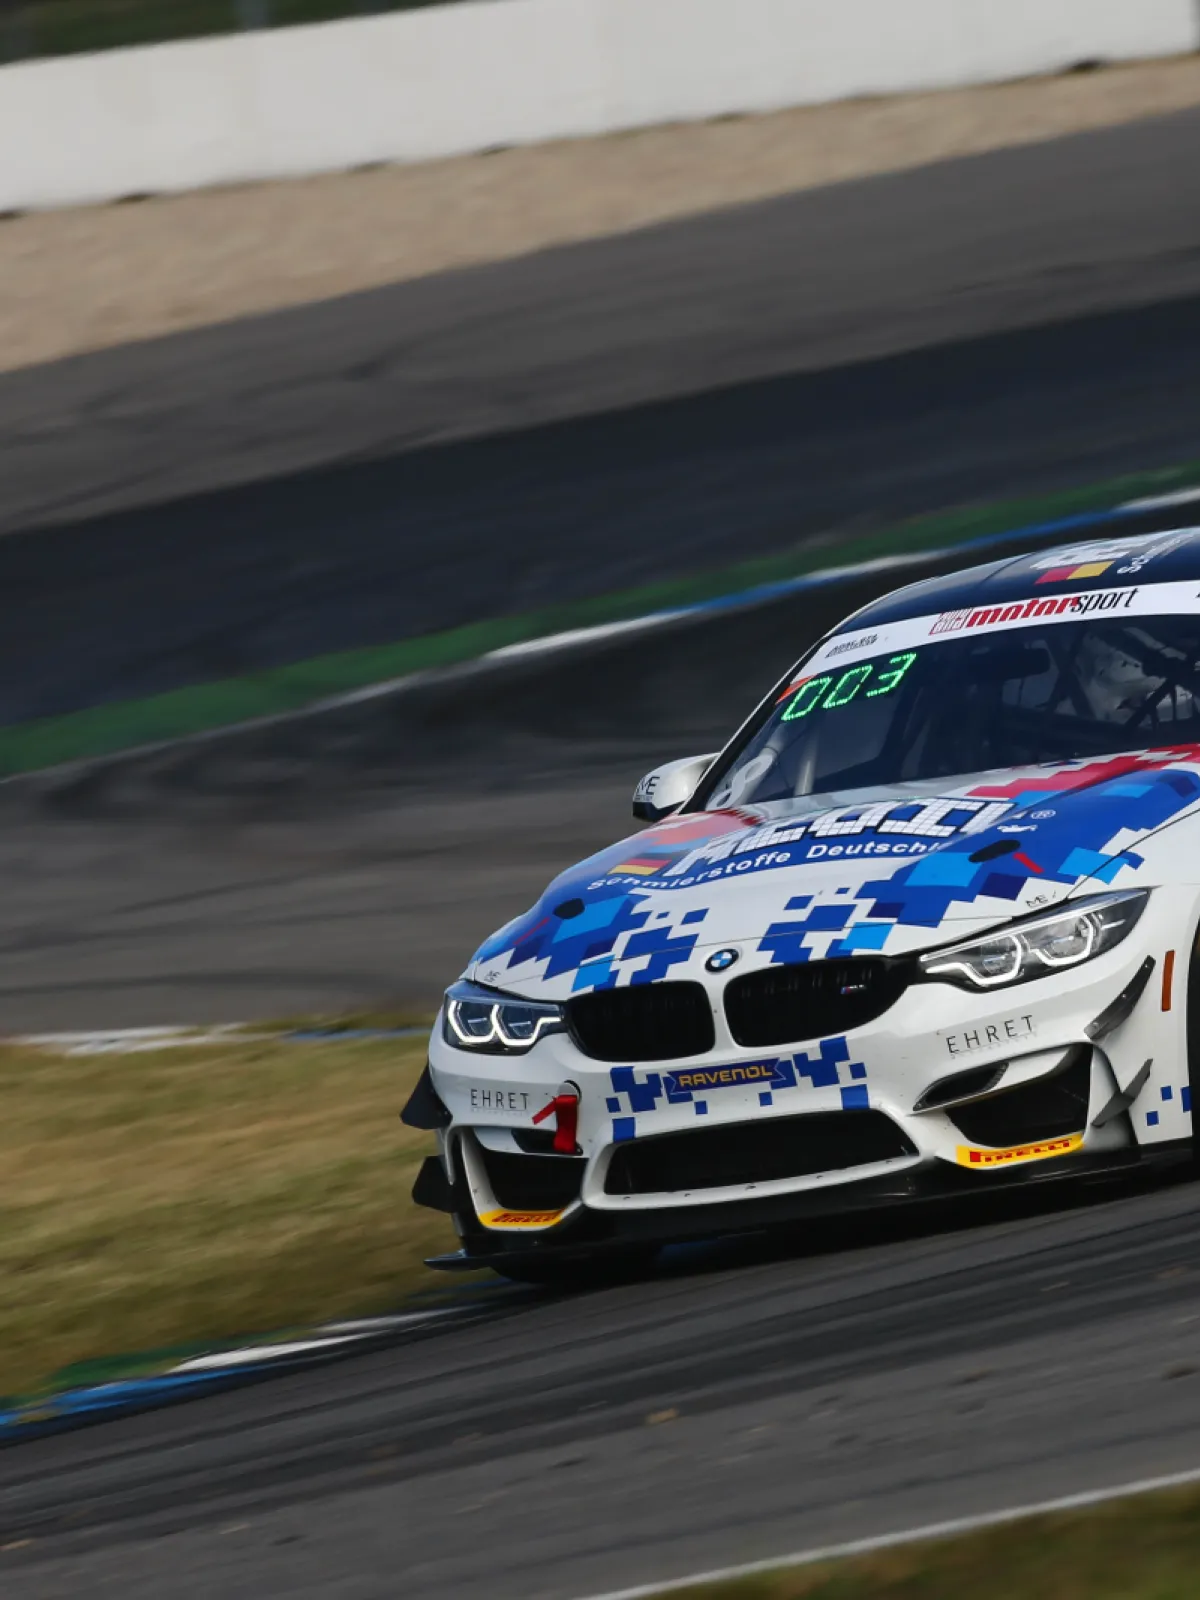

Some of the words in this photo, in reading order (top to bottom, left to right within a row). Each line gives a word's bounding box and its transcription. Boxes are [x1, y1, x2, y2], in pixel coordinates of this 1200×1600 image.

[966, 587, 1139, 628] motorsport
[781, 653, 917, 721] 003
[945, 1014, 1033, 1054] EHRET
[678, 1065, 773, 1087] RAVENOL
[470, 1088, 529, 1110] EHRET
